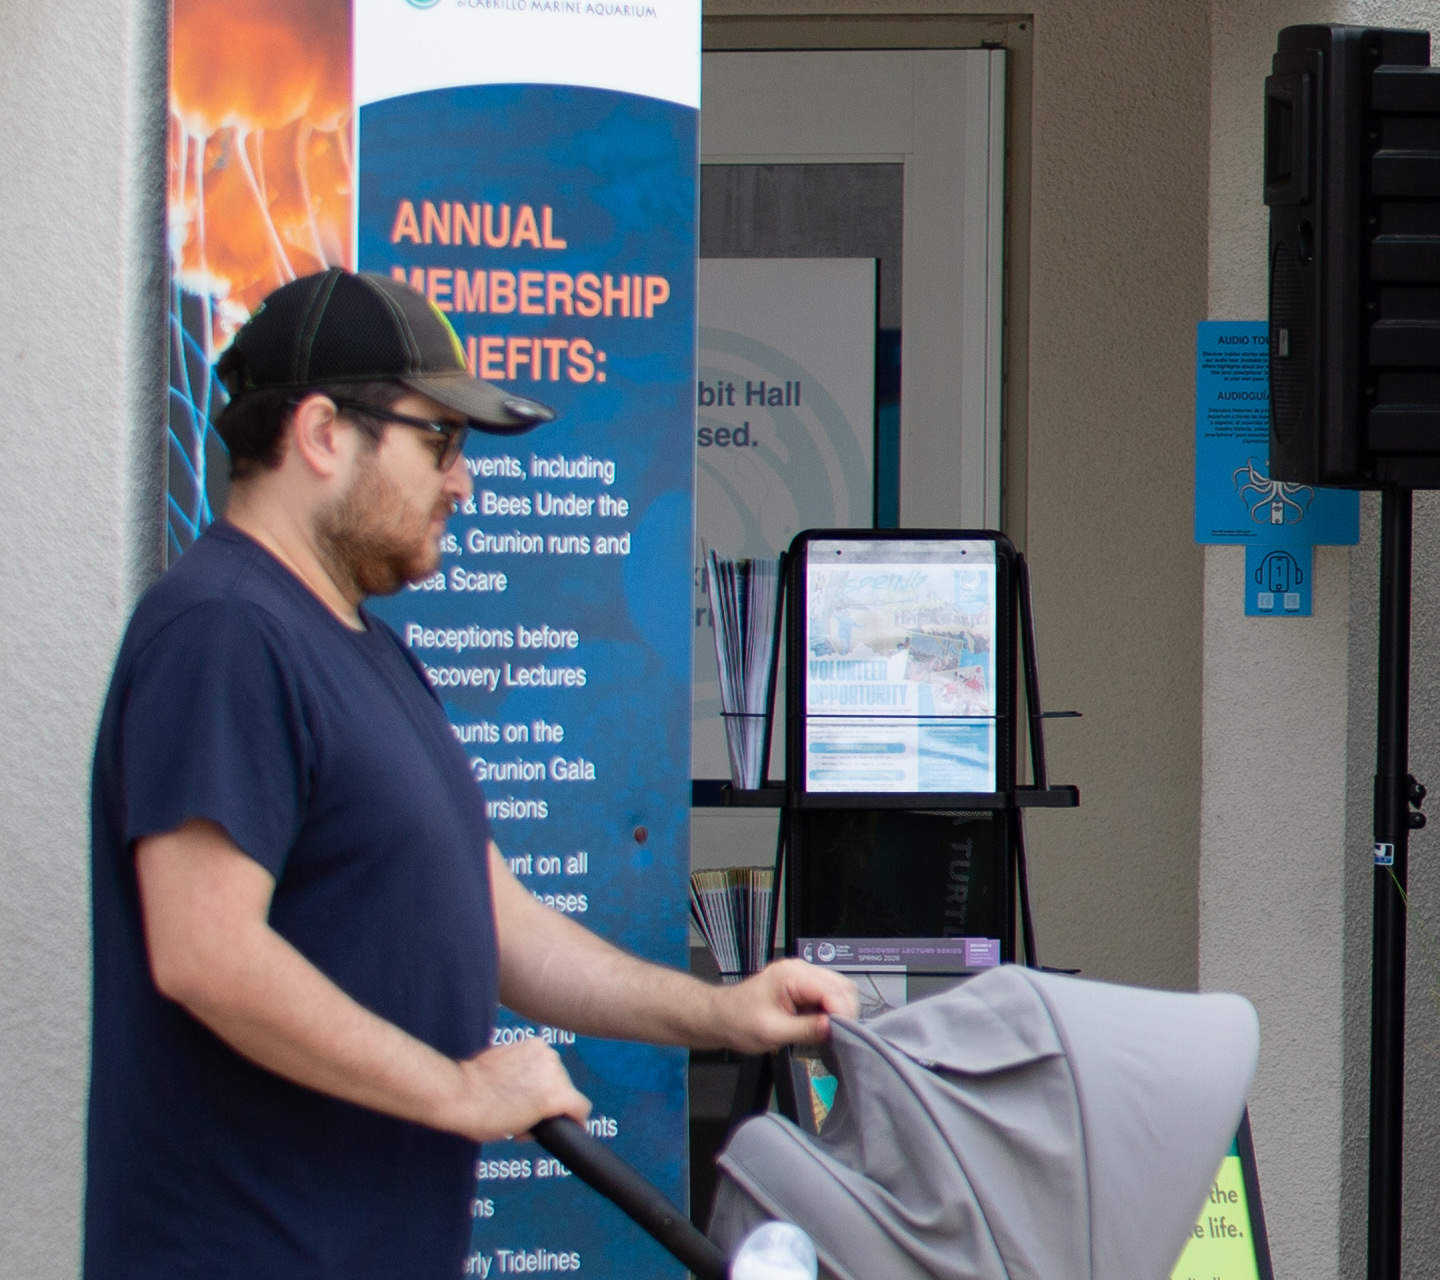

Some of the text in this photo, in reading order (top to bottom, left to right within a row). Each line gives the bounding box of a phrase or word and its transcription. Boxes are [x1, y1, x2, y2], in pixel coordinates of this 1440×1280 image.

[530, 0, 580, 14] MARINE
[585, 3, 656, 18] AQUARIUM
[392, 201, 566, 248] ANNUAL
[1218, 336, 1249, 344] AUDIO
[467, 336, 607, 383] EFITS:
[746, 381, 800, 407] Hall
[532, 455, 615, 485] including
[464, 494, 478, 515] &
[482, 492, 531, 515] Bees
[536, 493, 595, 516] Under
[599, 495, 629, 517] the
[468, 529, 630, 555] Grunion runs and
[451, 567, 507, 591] Scare
[407, 624, 579, 653] Receptions before
[422, 664, 586, 693] scovery Lectures
[808, 660, 887, 681] VOLUNTEER
[808, 684, 908, 706] OPPORTUNITY
[504, 720, 564, 742] on the
[471, 756, 596, 781] Grunion Gala
[536, 857, 561, 874] on
[566, 852, 587, 874] all
[1210, 1182, 1237, 1204] the
[1209, 1216, 1243, 1238] life.
[497, 1249, 580, 1272] Tidelines
